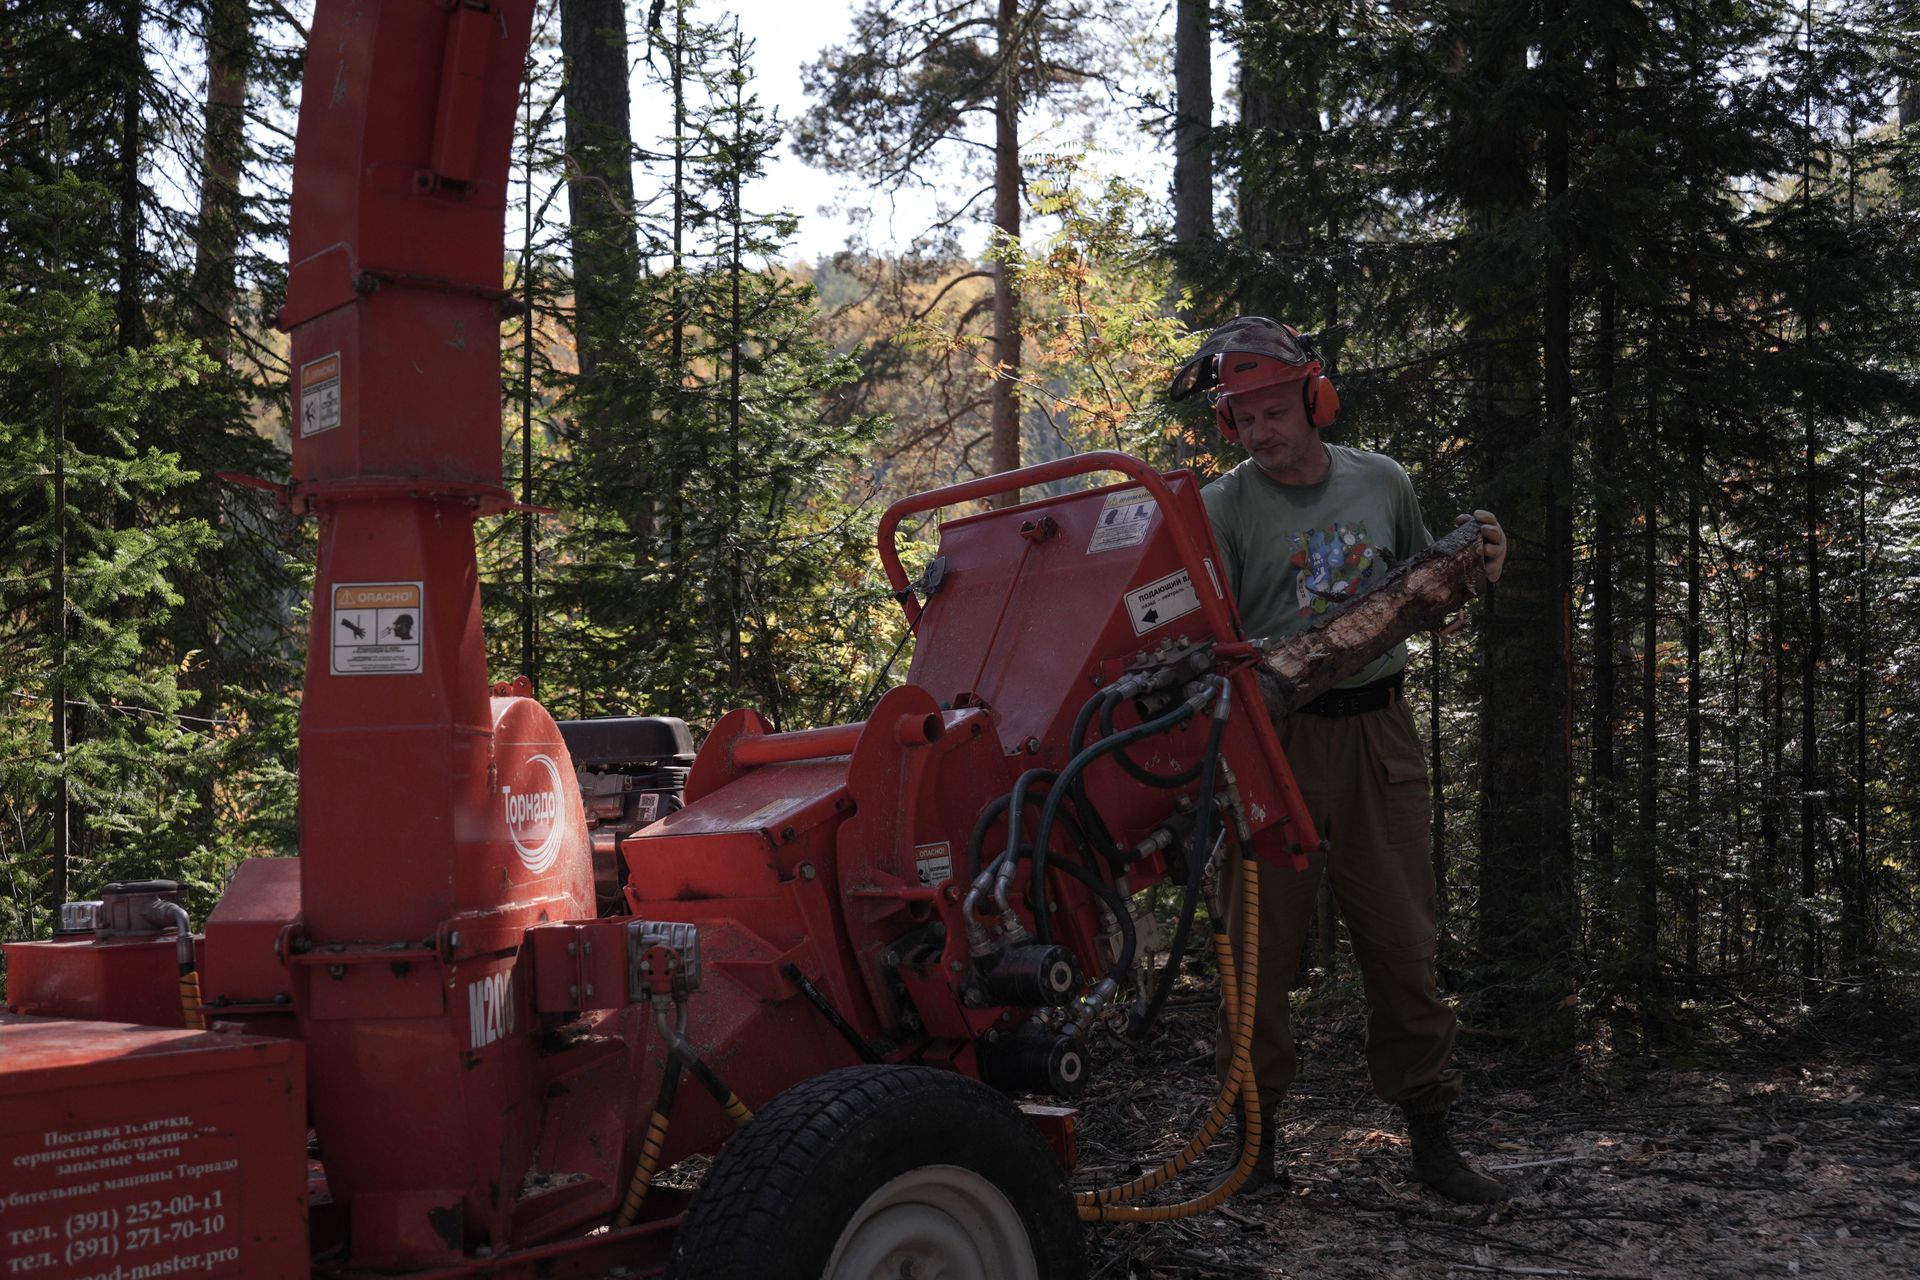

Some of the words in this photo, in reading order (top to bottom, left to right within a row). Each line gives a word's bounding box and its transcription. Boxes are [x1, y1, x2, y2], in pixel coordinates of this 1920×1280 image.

[358, 592, 412, 603] ОПАСНО!
[1138, 578, 1181, 602] ПОДАЮЩИЙ
[502, 786, 556, 832] Торнадо
[919, 847, 945, 857] ОПАСНО!
[44, 1126, 120, 1147] Поставка
[13, 1144, 98, 1168] сервисное
[55, 1155, 132, 1175] запасные
[136, 1147, 180, 1162] части
[104, 1170, 173, 1191] машины
[176, 1159, 239, 1178] Торнадо
[8, 1225, 58, 1245] тел.
[65, 1207, 119, 1240] (391)
[8, 1252, 58, 1273] тел.
[65, 1233, 119, 1266] (391)
[126, 1214, 224, 1250] 271-70-10
